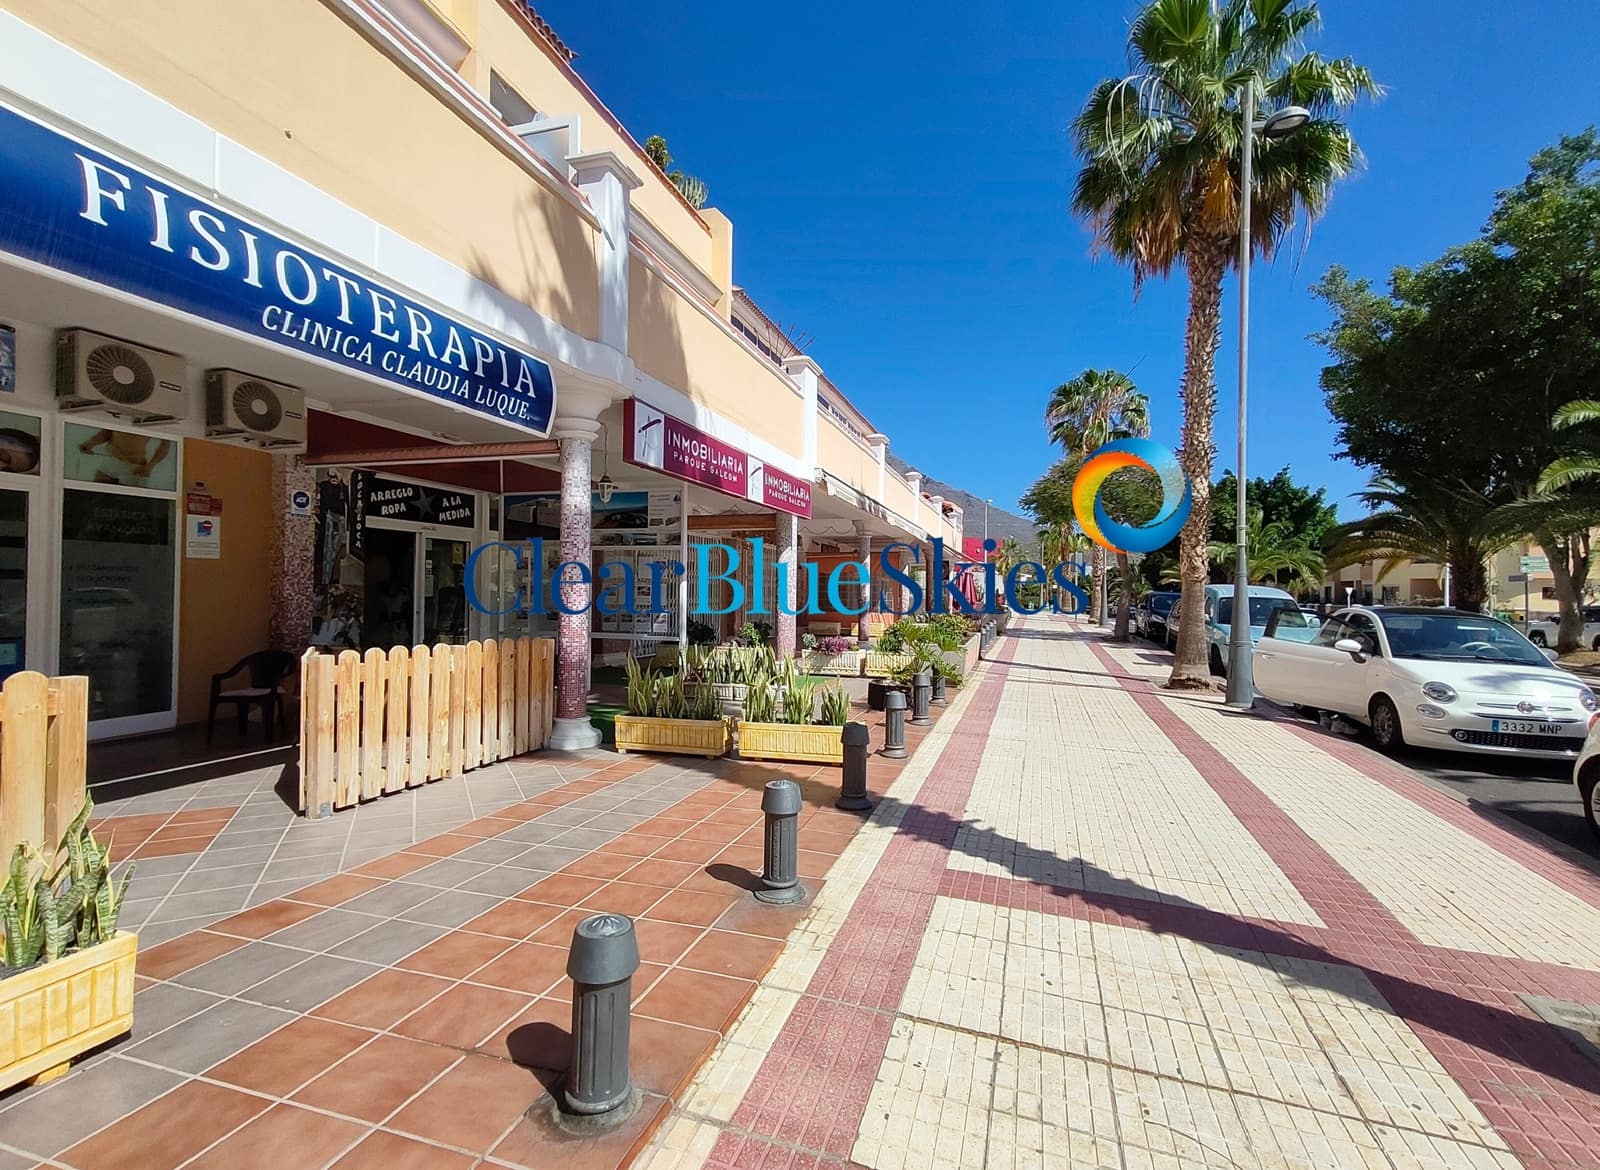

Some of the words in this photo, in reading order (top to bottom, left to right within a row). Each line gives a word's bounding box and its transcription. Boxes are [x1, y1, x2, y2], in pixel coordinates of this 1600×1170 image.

[73, 152, 537, 399] FISIOTERAPIA
[262, 305, 373, 365] CLINICA
[382, 350, 470, 399] CLAUDIA
[475, 384, 531, 420] LUQUE.
[667, 429, 744, 475] INMOBILIARIA
[765, 472, 810, 501] INMOBILIARIA
[370, 487, 414, 502] ARREGLO
[442, 498, 450, 507] A
[451, 495, 462, 506] LA
[381, 502, 407, 515] ROPA
[439, 507, 471, 522] MEDIDA
[1501, 721, 1534, 733] 3332
[1539, 725, 1562, 734] MNP
